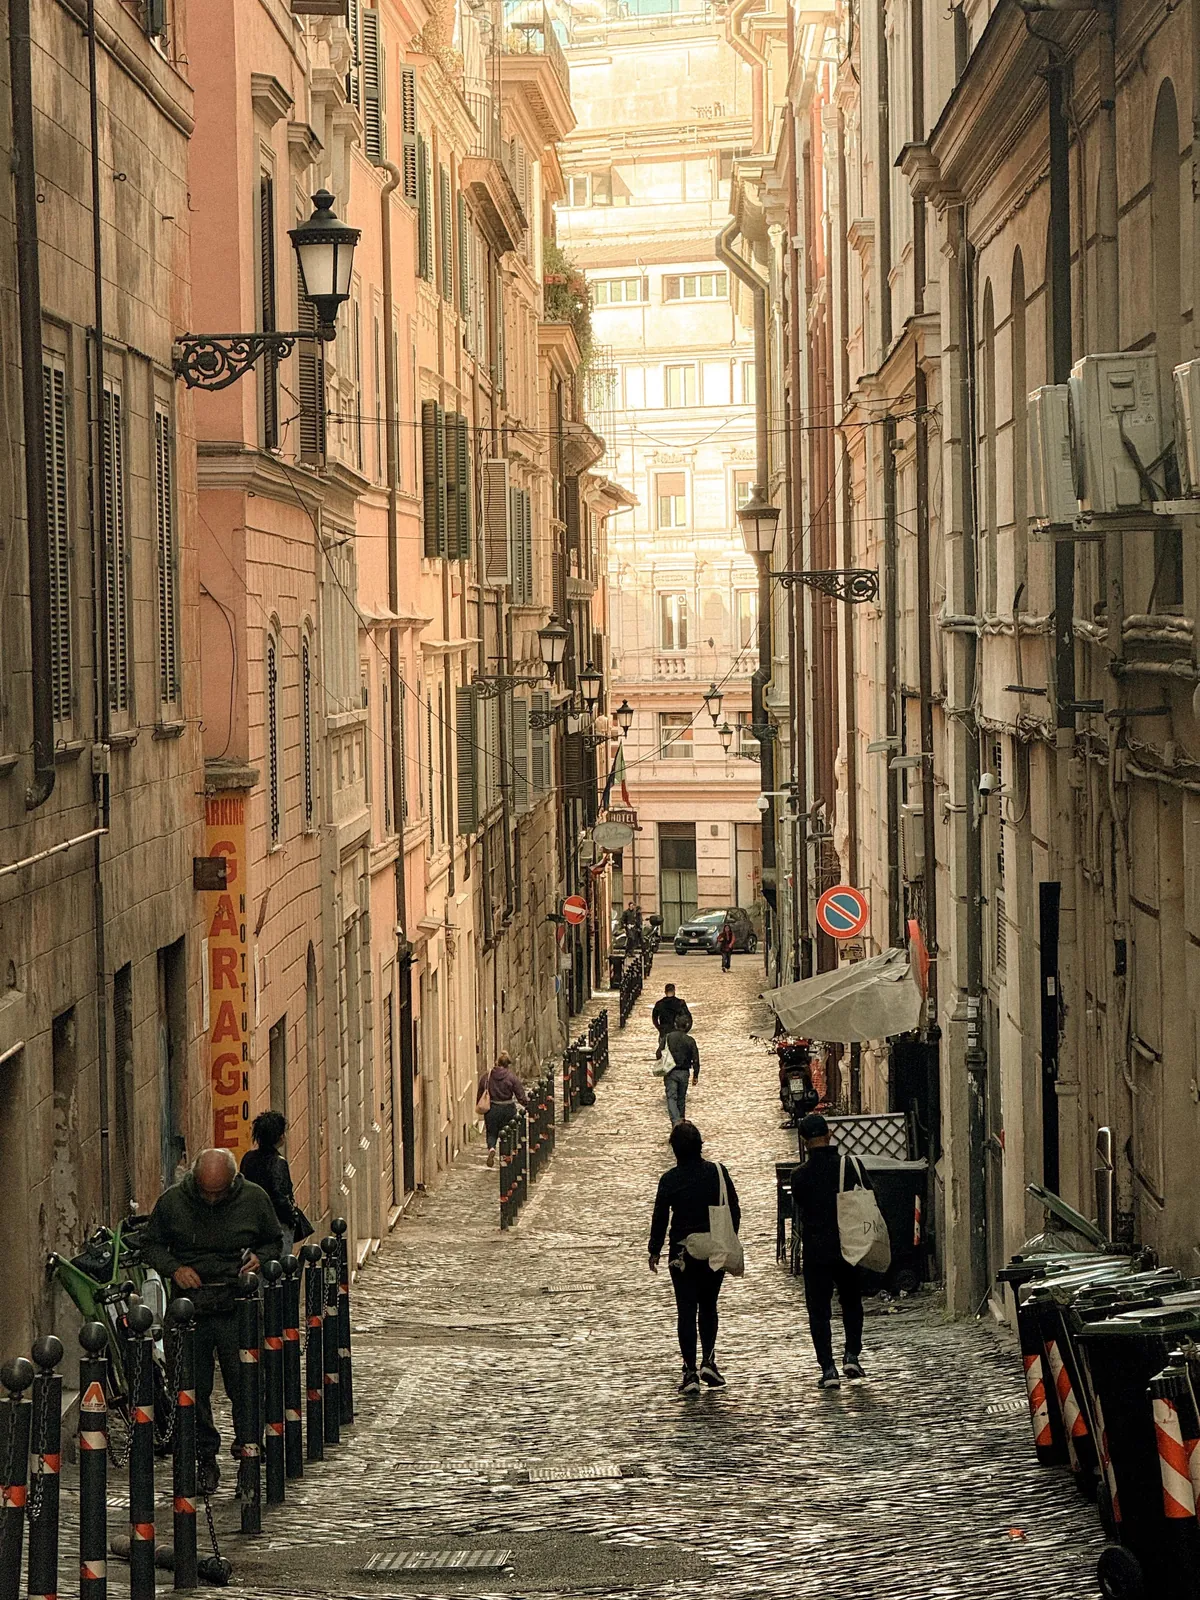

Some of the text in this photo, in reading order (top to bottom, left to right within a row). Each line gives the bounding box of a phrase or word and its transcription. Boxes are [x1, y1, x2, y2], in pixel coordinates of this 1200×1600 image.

[611, 814, 634, 822] HOTEL
[208, 840, 241, 1148] GARAGE
[239, 893, 249, 1121] NOTTURNO
